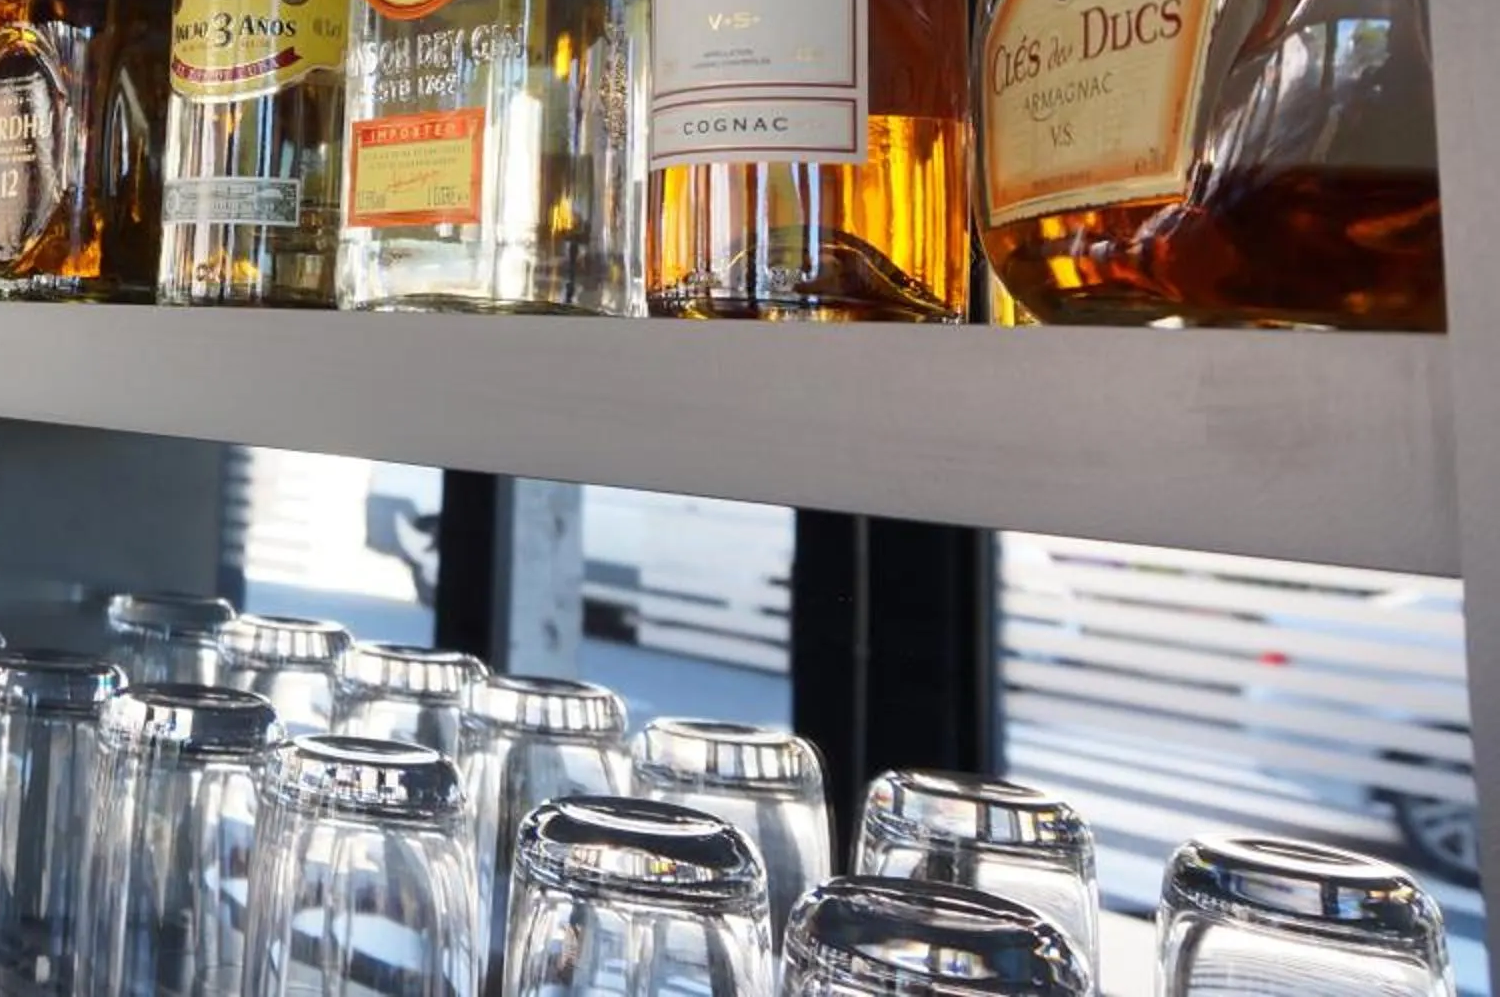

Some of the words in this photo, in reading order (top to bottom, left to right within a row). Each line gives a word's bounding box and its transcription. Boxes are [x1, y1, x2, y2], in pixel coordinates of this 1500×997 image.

[212, 12, 234, 48] 3
[684, 116, 789, 136] COGNAC
[0, 168, 19, 200] 12
